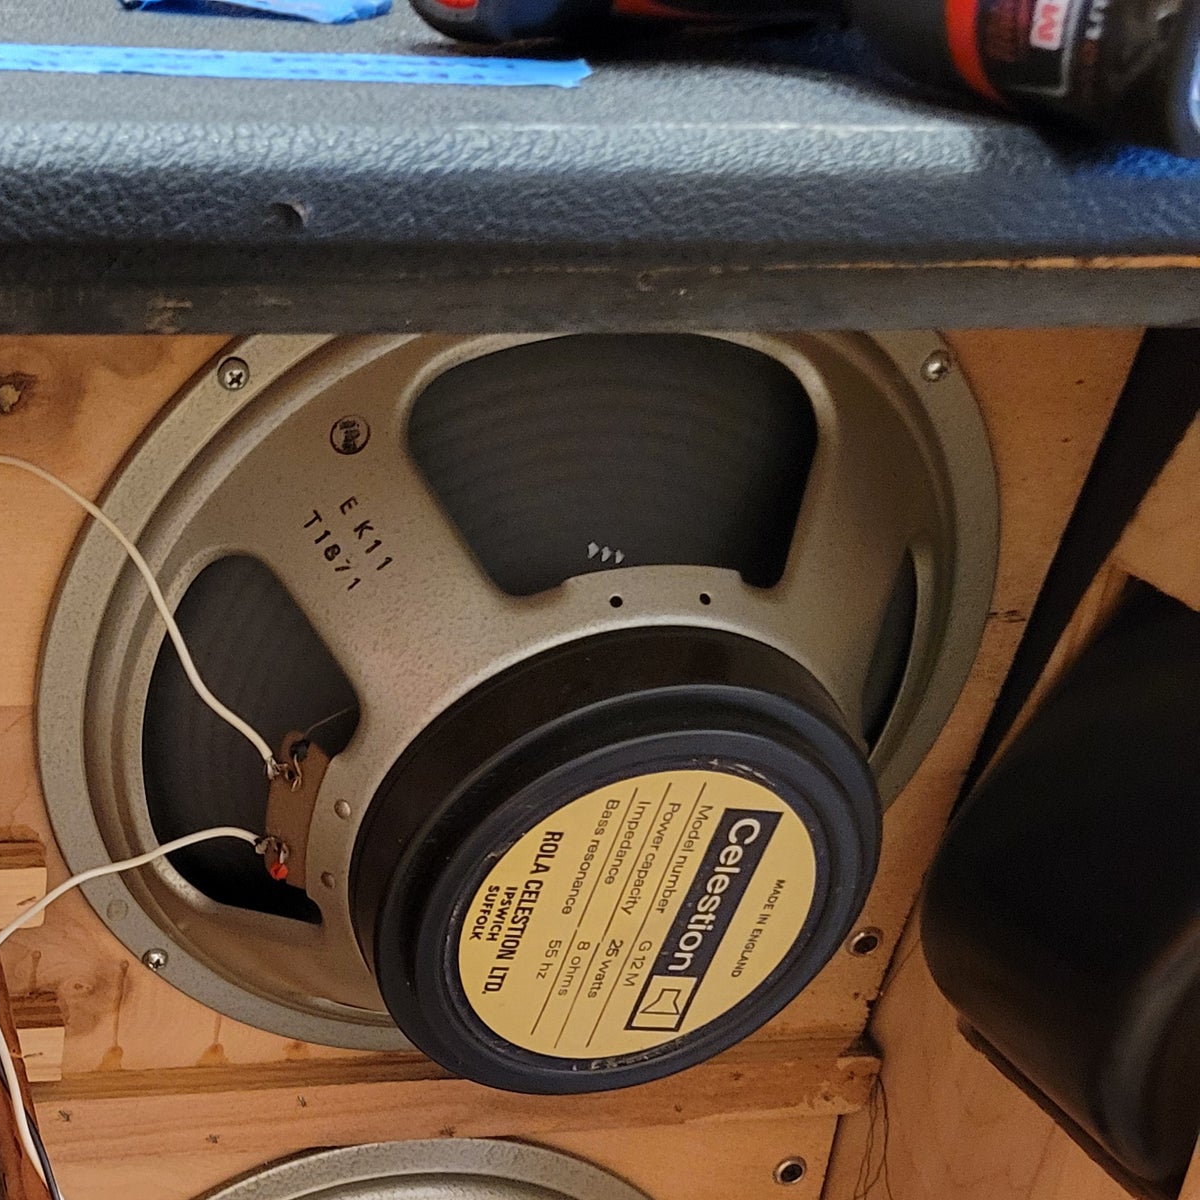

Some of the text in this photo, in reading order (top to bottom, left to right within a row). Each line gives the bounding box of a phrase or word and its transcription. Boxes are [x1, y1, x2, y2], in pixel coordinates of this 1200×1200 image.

[535, 800, 621, 979] Bass resonance 55 hz
[654, 856, 690, 913] number
[681, 805, 714, 851] Model
[468, 885, 503, 940] SUFFOLK
[480, 831, 565, 995] ROLA CELESTION LTD.
[484, 886, 519, 942] IPSWICH
[556, 802, 651, 996] Impedance 8 ohms
[586, 803, 682, 998] Power capacity 25 watts
[667, 818, 765, 971] Celestion
[729, 879, 786, 977] MADE IN ENGLAND
